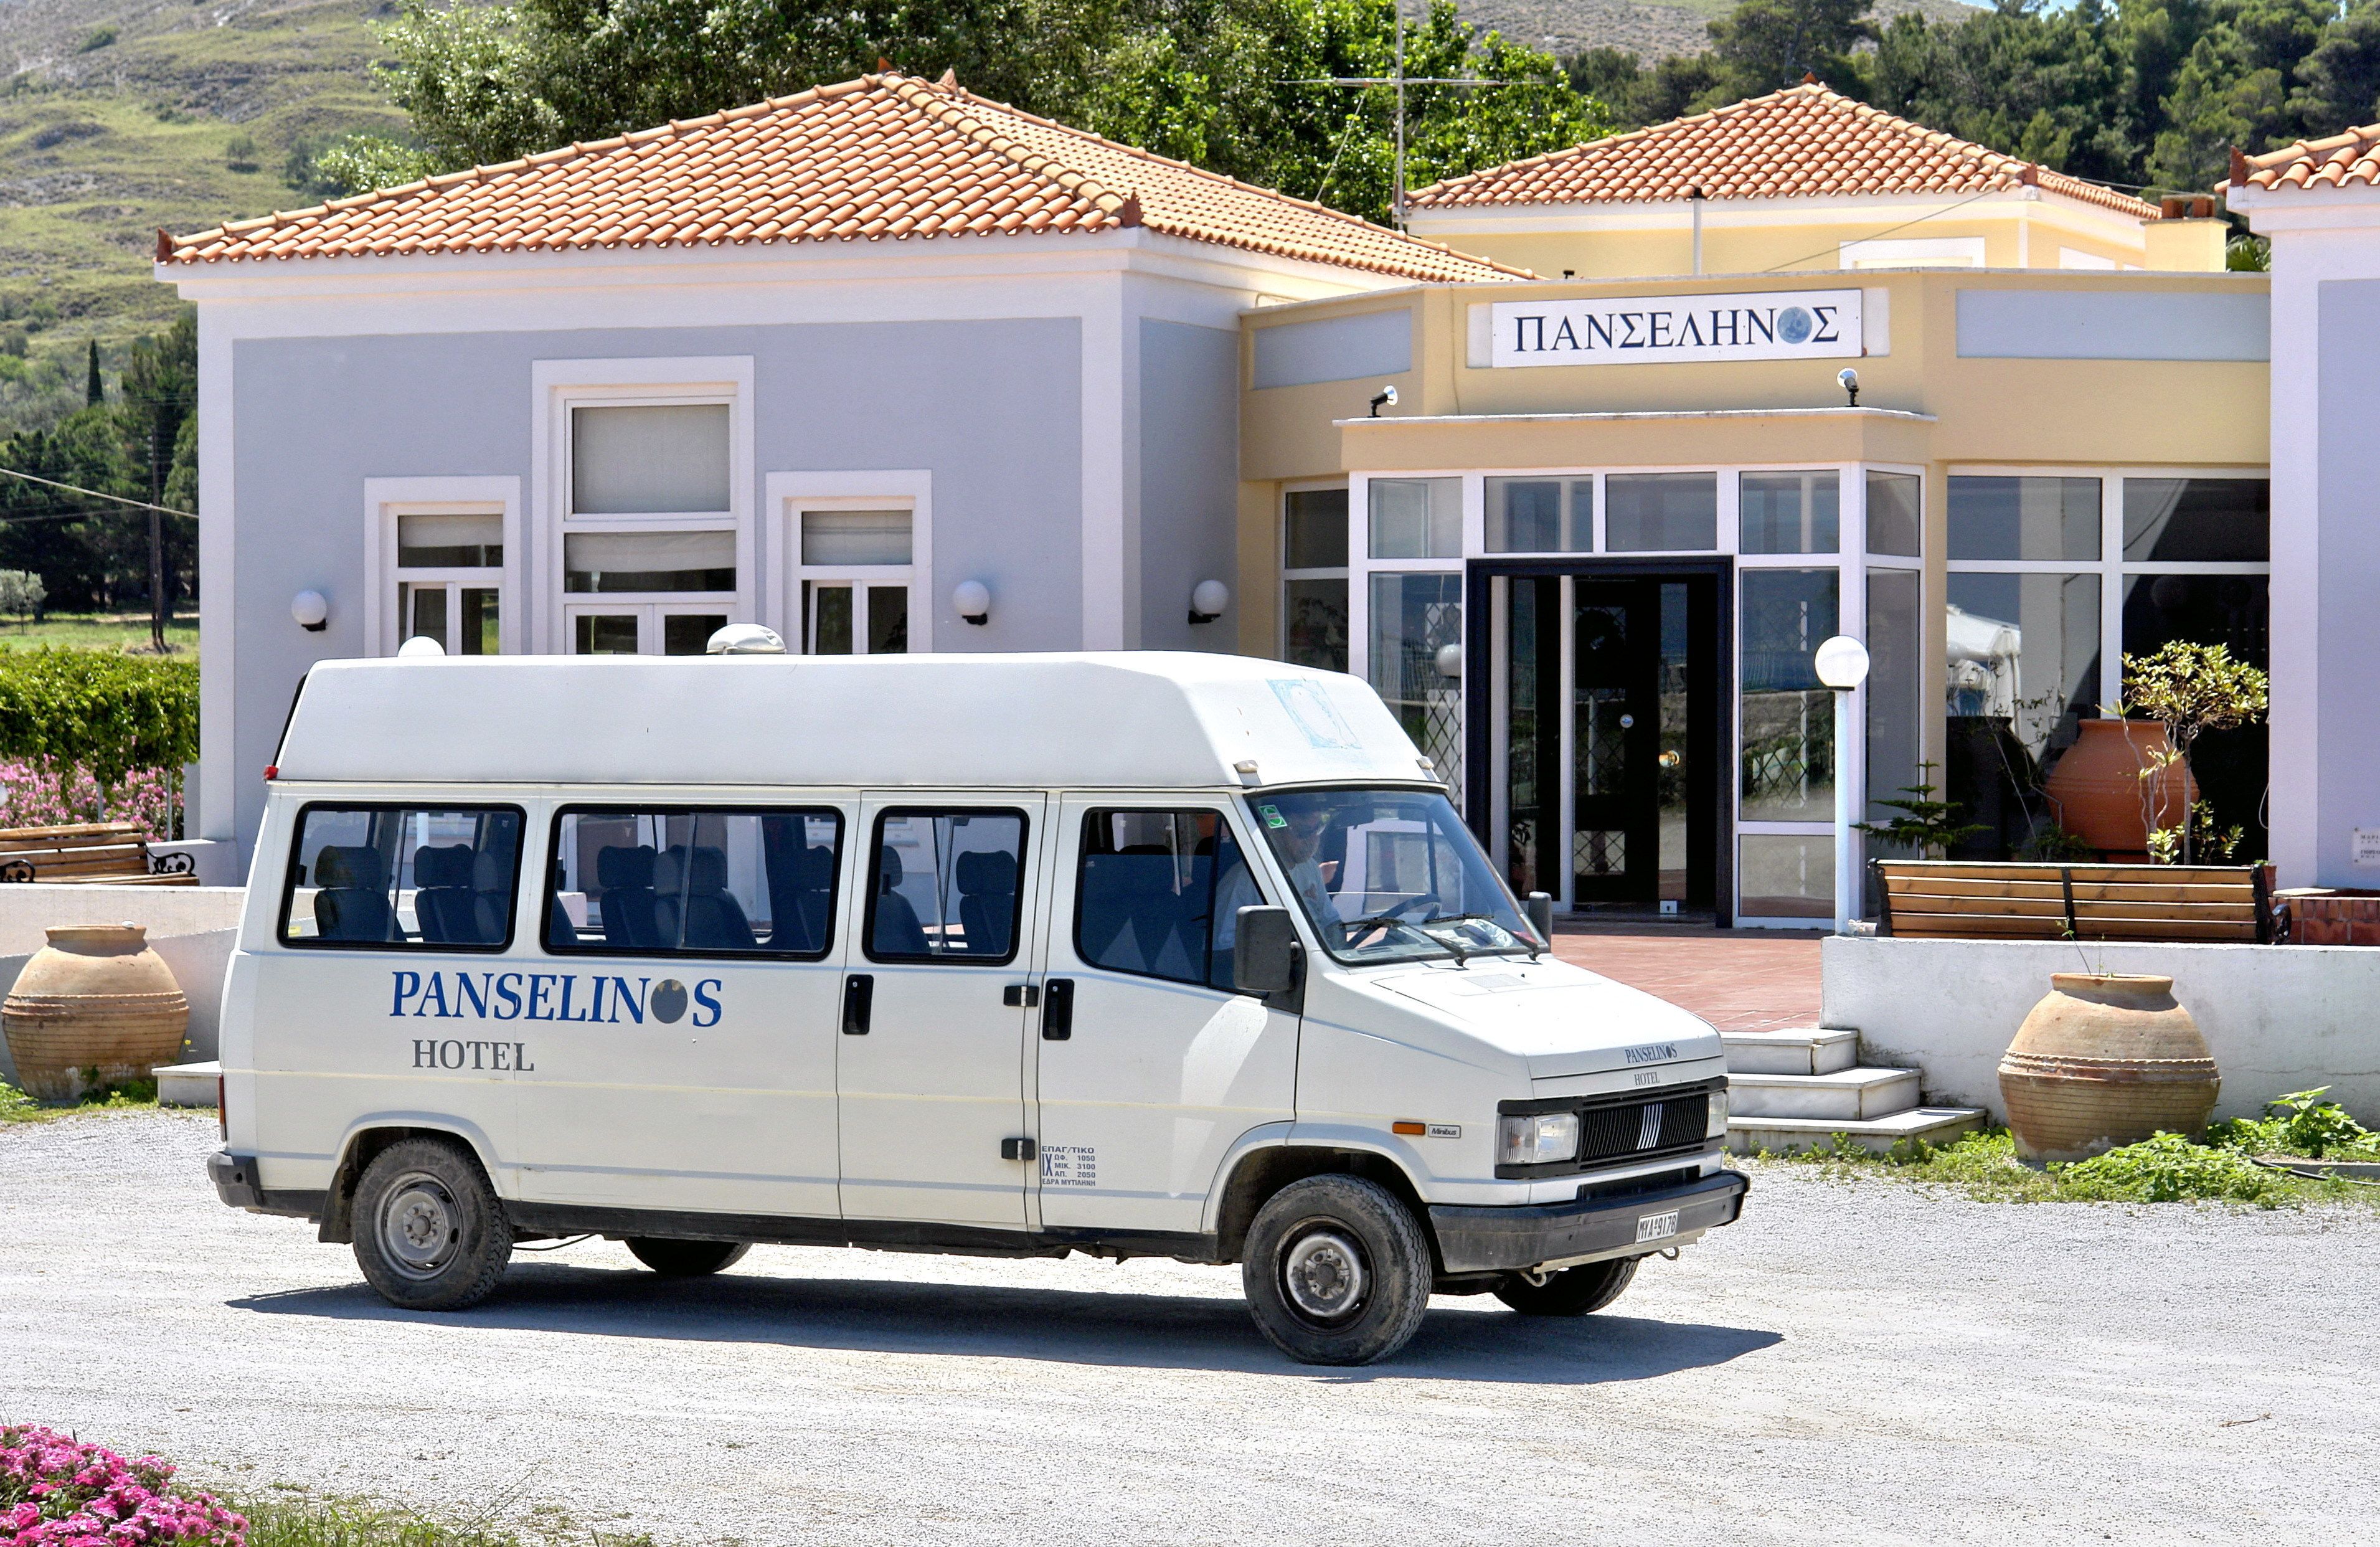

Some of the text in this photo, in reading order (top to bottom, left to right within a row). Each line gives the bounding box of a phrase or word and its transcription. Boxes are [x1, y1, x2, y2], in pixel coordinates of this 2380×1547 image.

[1514, 306, 1840, 352] ΠΑΝΣΕΛΗΝΟΣ
[389, 971, 722, 1028] PANSELINOS
[412, 1039, 534, 1071] HOTEL
[1624, 1043, 1678, 1064] PANSELINOS
[1633, 1071, 1660, 1086] HOTEL
